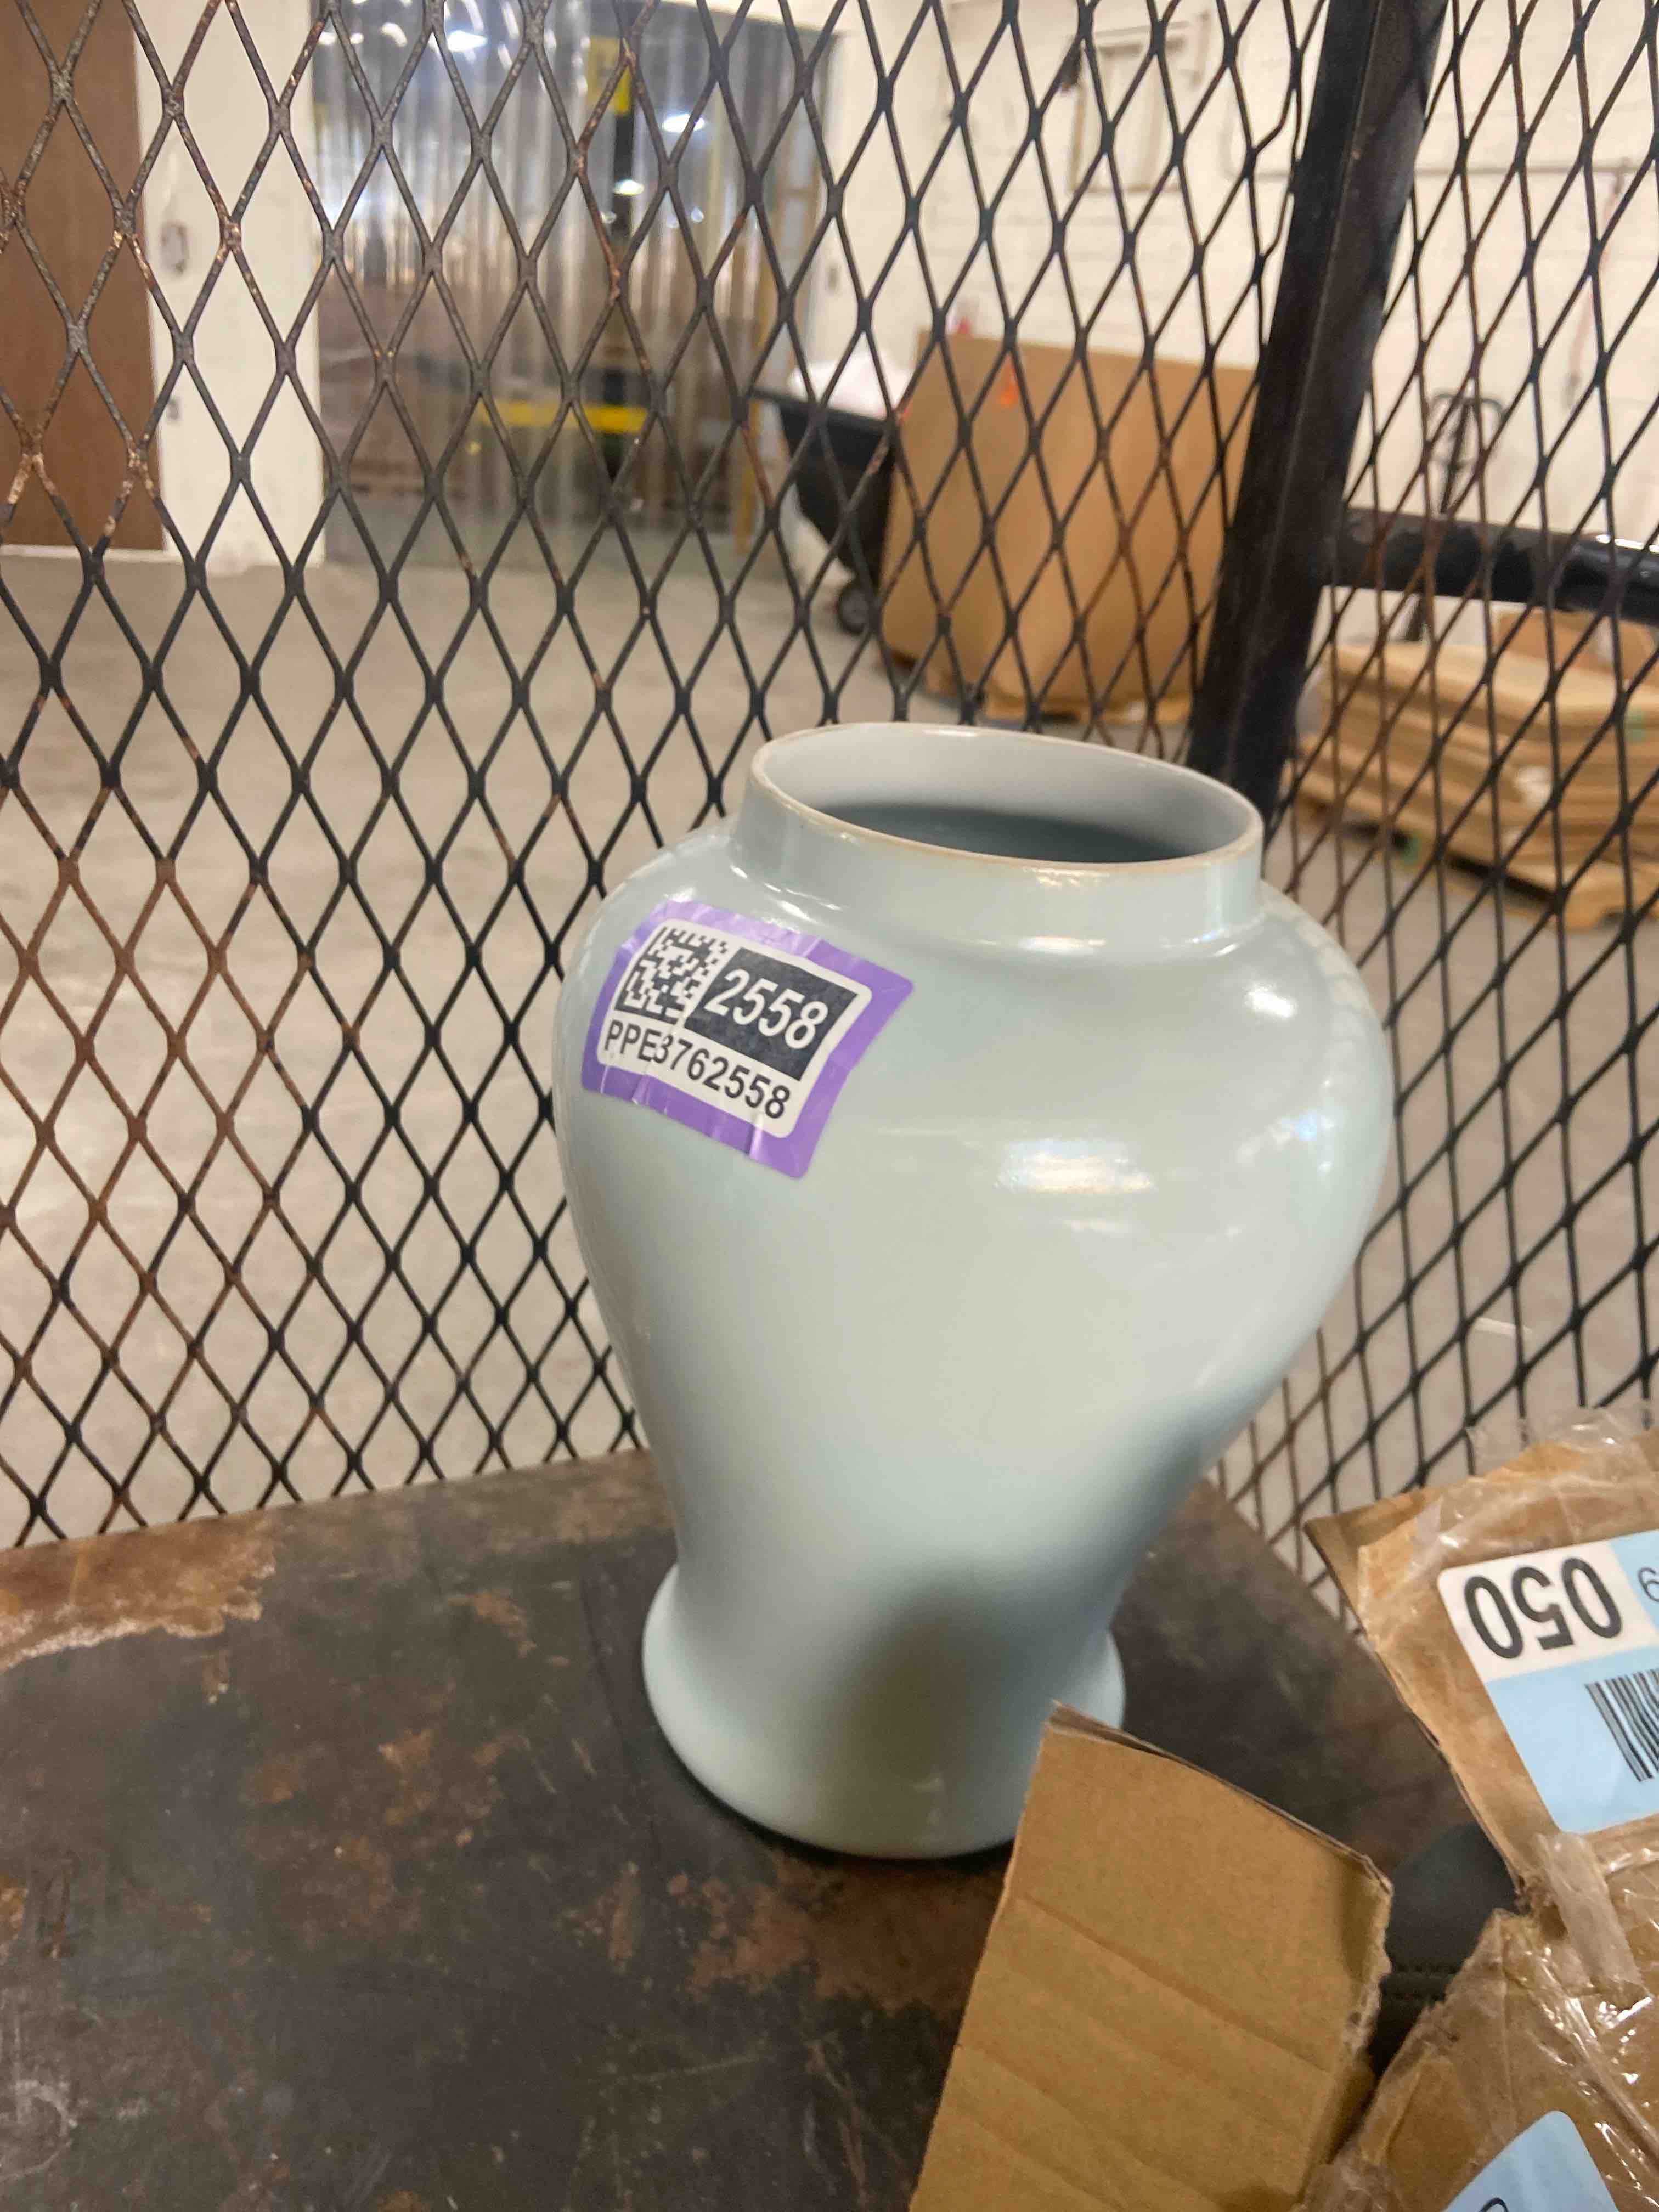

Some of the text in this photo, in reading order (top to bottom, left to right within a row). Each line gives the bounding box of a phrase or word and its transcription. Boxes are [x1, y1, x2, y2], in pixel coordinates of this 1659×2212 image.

[704, 969, 828, 1049] 2558
[605, 1020, 790, 1119] PPE3762558
[1464, 1558, 1622, 1659] 050
